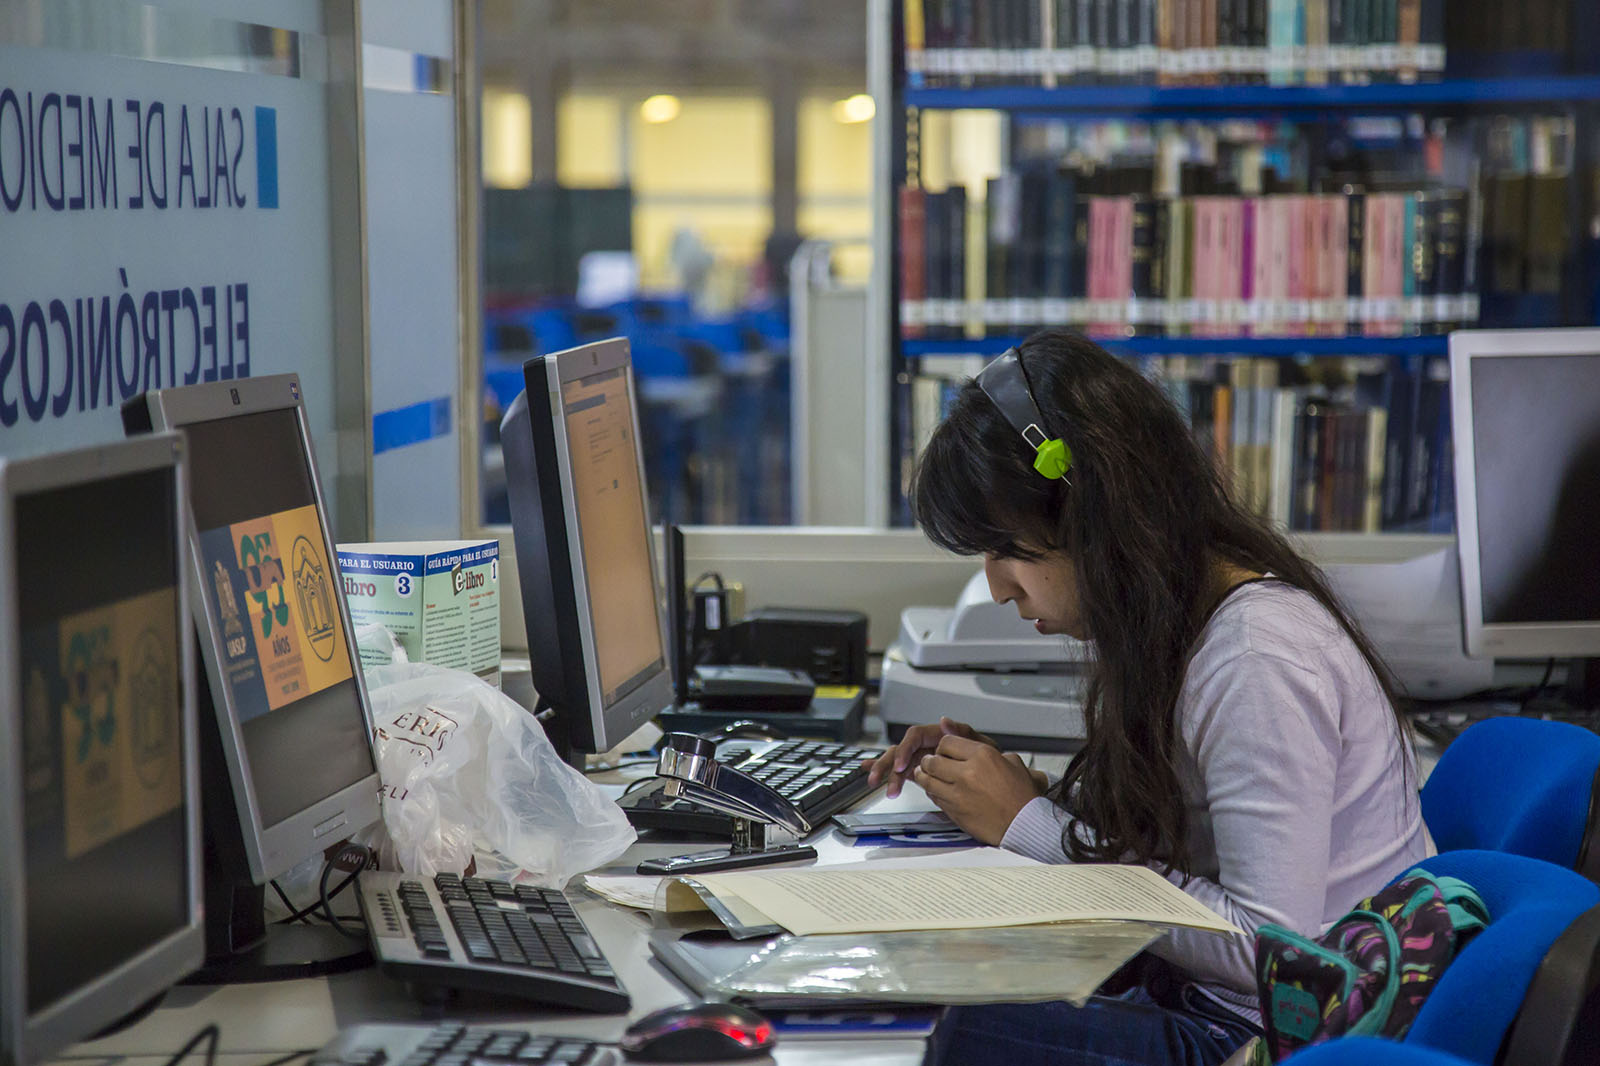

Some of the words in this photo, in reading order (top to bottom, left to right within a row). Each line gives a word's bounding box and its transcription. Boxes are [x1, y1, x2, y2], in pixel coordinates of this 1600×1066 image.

[338, 557, 359, 569] PARA
[360, 559, 372, 569] EL
[372, 560, 415, 571] USUARIO
[428, 557, 442, 569] GUÍA
[462, 552, 475, 563] PARA
[492, 562, 497, 579] 1
[398, 576, 411, 595] 3
